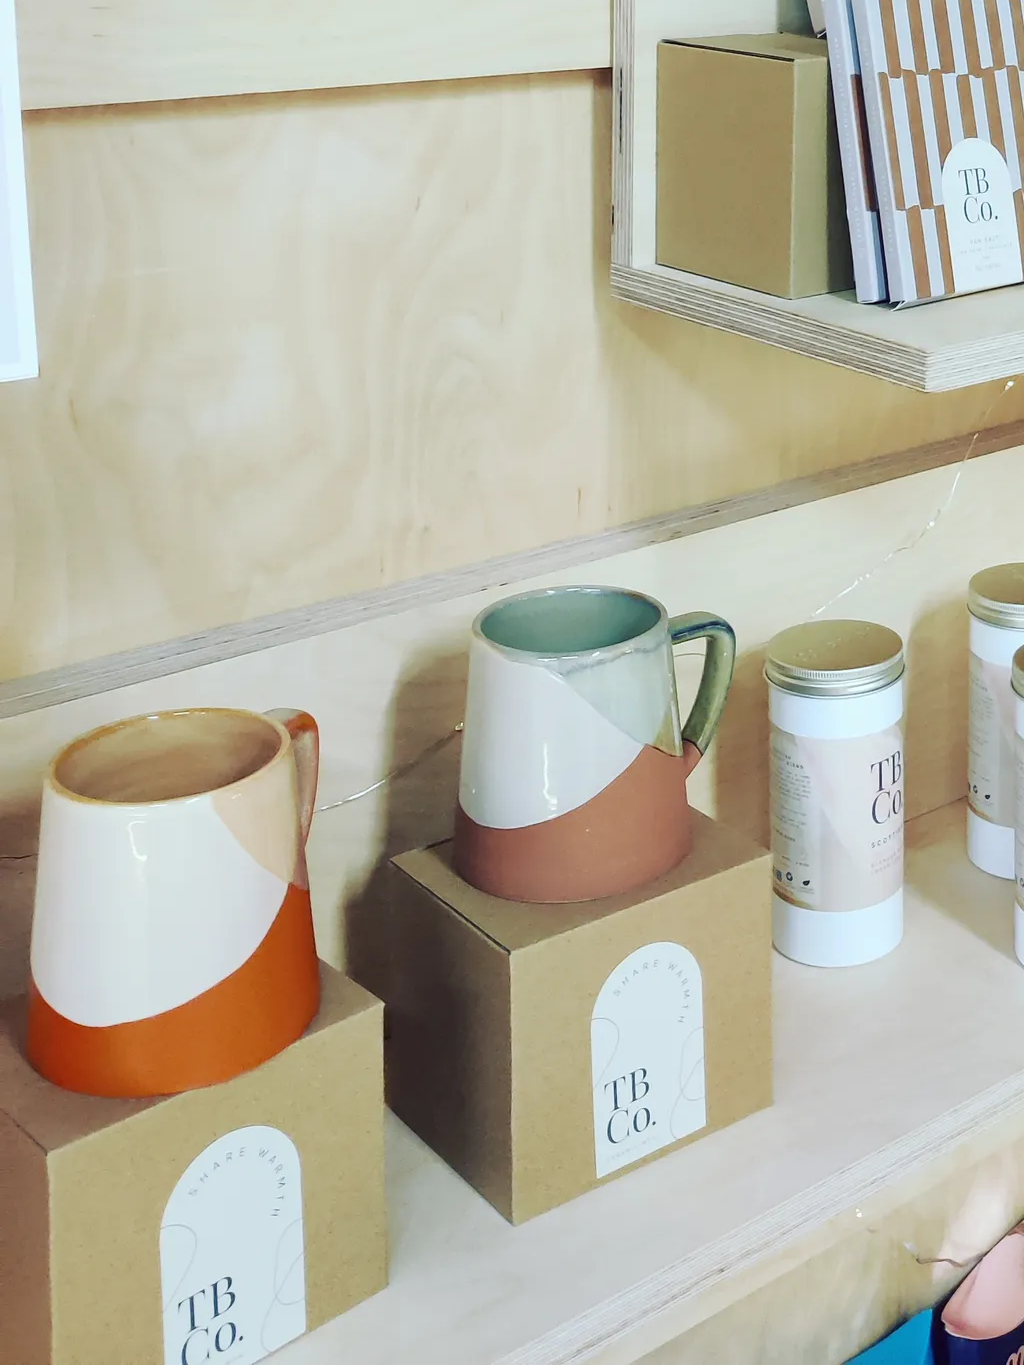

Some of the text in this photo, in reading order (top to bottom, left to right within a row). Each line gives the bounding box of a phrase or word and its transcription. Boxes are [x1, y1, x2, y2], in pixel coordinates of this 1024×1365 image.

[958, 167, 989, 196] TB
[963, 196, 998, 224] Co.
[871, 751, 901, 792] TB
[614, 959, 690, 1024] SHARE WARMTH
[603, 1067, 650, 1112] TB
[606, 1107, 657, 1145] Co.
[188, 1147, 286, 1217] SHARE WARMTH
[178, 1276, 236, 1334] TB
[180, 1321, 244, 1365] Co.
